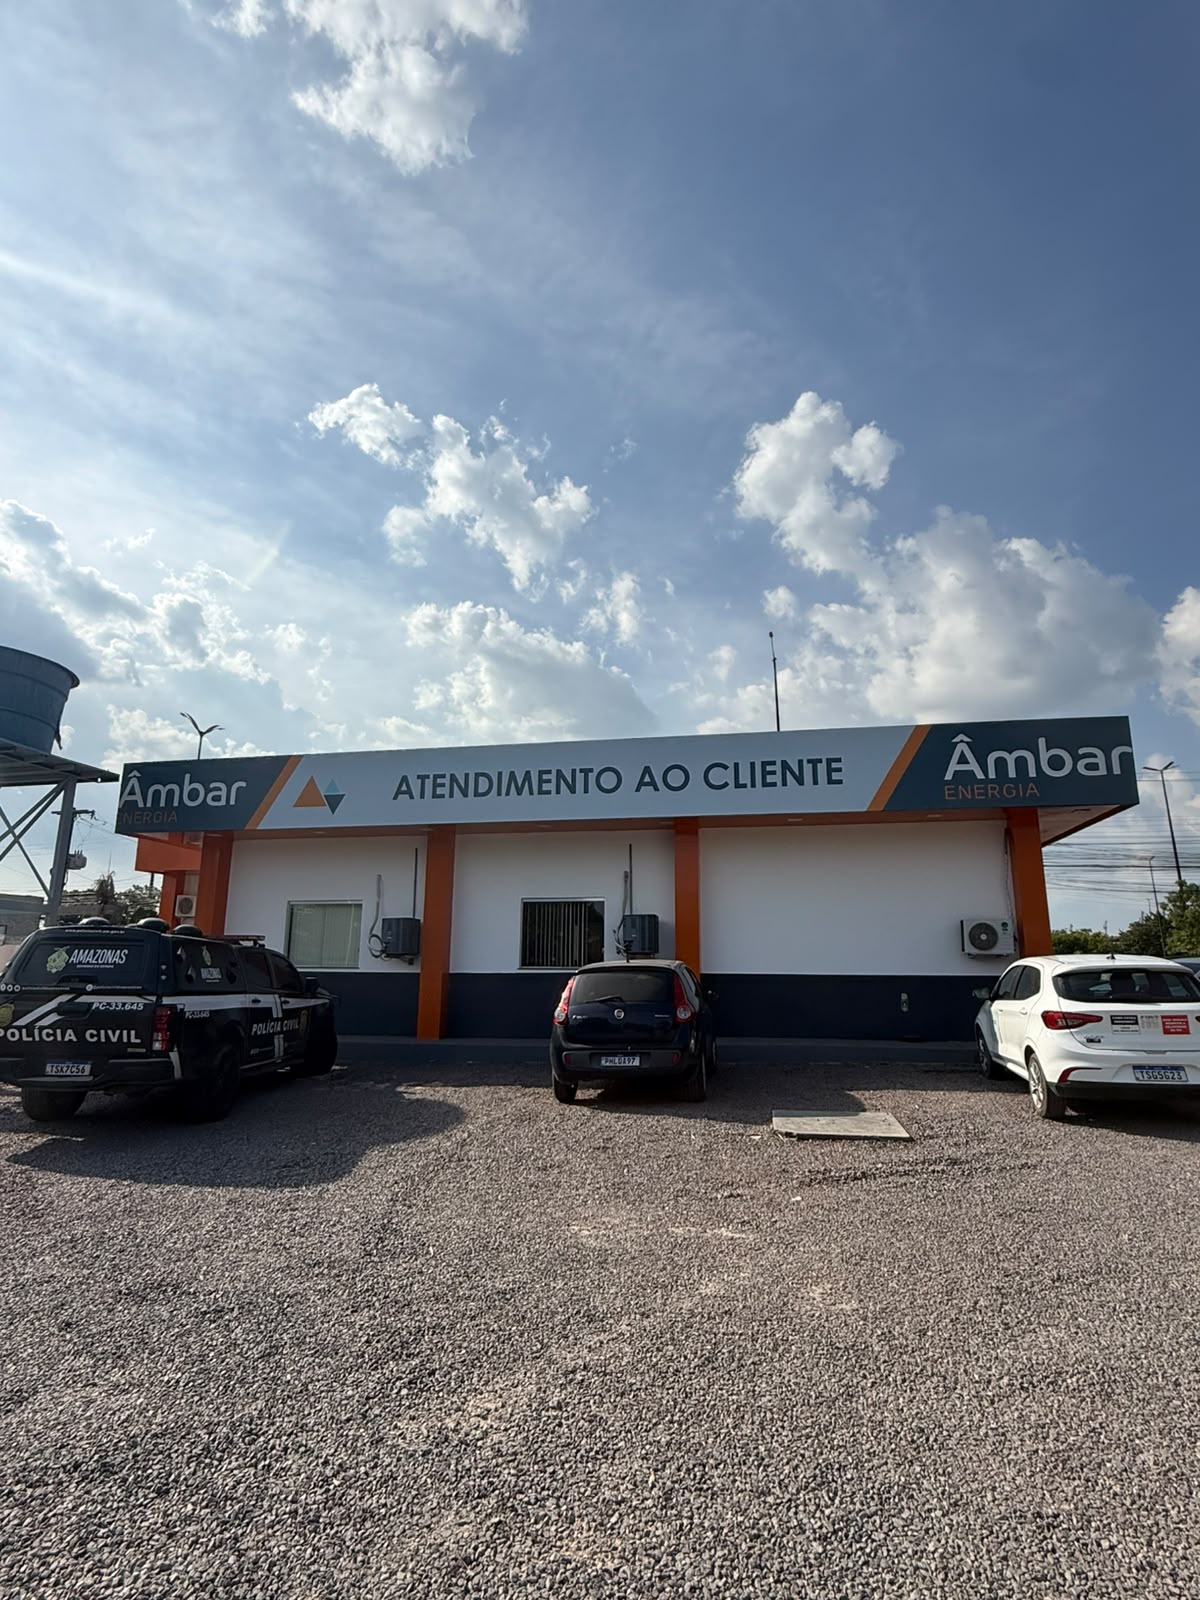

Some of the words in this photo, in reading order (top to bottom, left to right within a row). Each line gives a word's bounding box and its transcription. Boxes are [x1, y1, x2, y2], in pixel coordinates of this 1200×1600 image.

[944, 733, 1133, 780] Âmbar
[393, 766, 623, 801] ATENDIMENTO
[635, 763, 691, 793] AO
[703, 756, 844, 791] CLIENTE
[118, 769, 247, 808] Âmbar
[944, 782, 1040, 800] ENERGIA
[68, 948, 129, 965] AMAZONAS
[92, 1002, 144, 1011] PC-33.645
[251, 1019, 282, 1036] POLÍCIA
[282, 1018, 300, 1032] CIVIL
[85, 1029, 142, 1043] CIVIL
[49, 1064, 87, 1075] TSK7C56
[1139, 1070, 1183, 1081] TSG5G23
